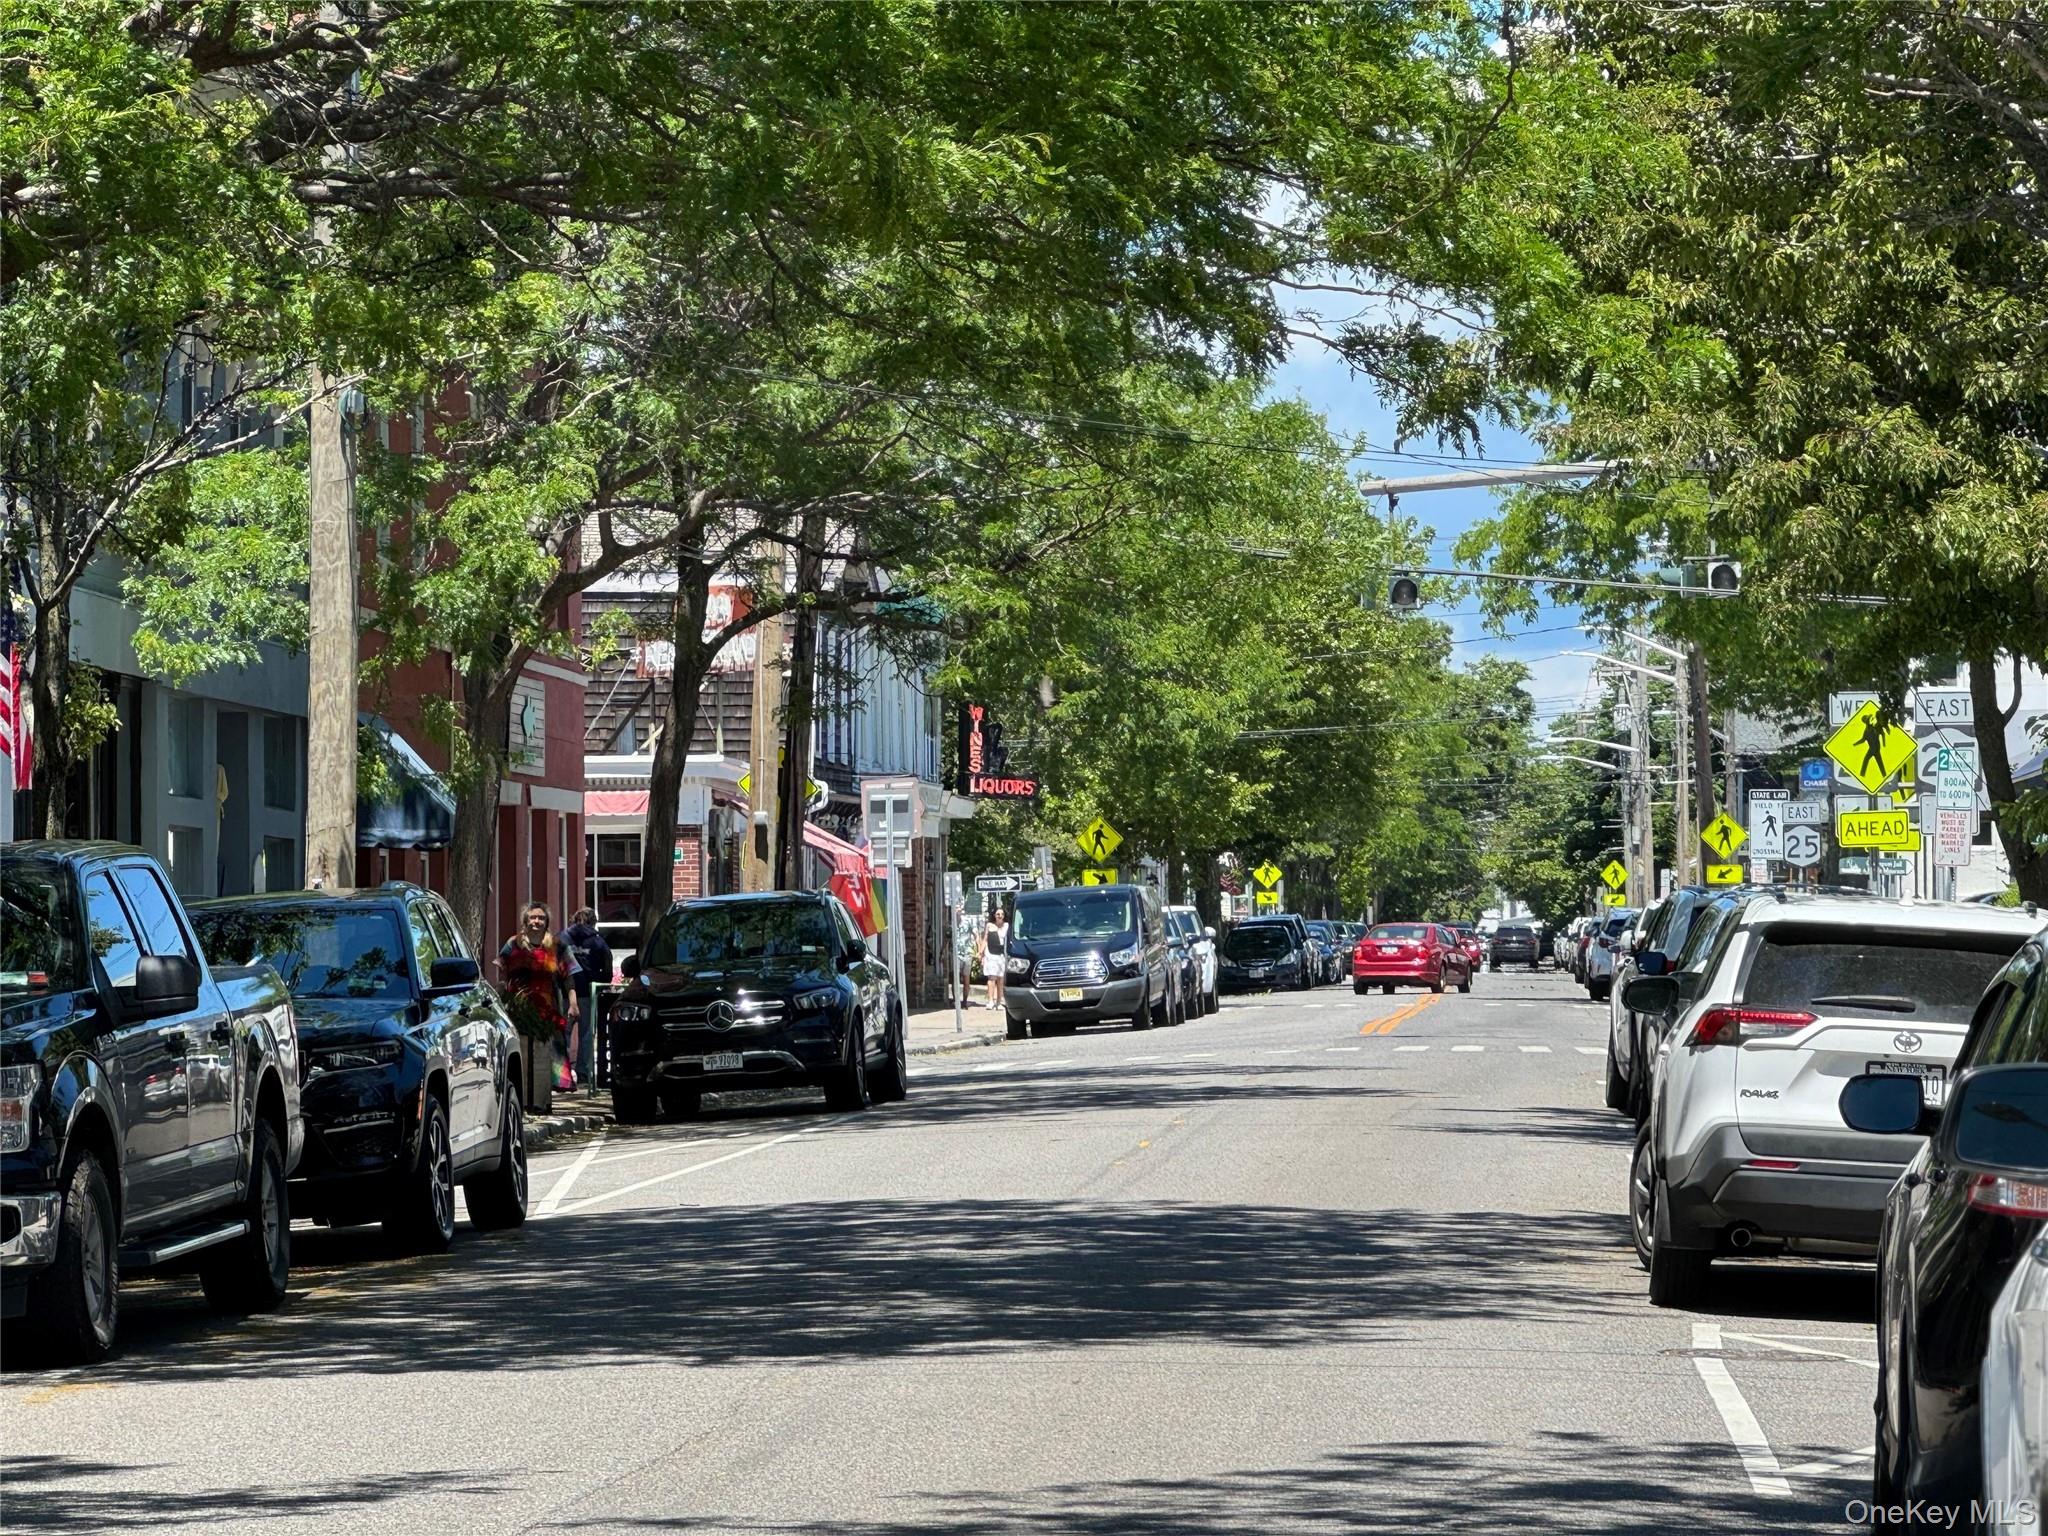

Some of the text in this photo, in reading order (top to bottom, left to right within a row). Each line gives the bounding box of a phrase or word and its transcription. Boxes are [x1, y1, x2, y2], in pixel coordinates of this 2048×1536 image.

[1926, 698, 1970, 717] EAST
[968, 704, 984, 773] WINES
[1940, 752, 1948, 768] 2
[970, 776, 1037, 795] LIQUORS
[1803, 780, 1829, 788] CHASE
[1751, 791, 1770, 799] STATE
[1788, 806, 1815, 819] EAST
[1845, 820, 1905, 837] AHEAD
[1787, 835, 1818, 858] 25
[994, 880, 1007, 888] WAY
[1905, 1066, 1926, 1074] YORK
